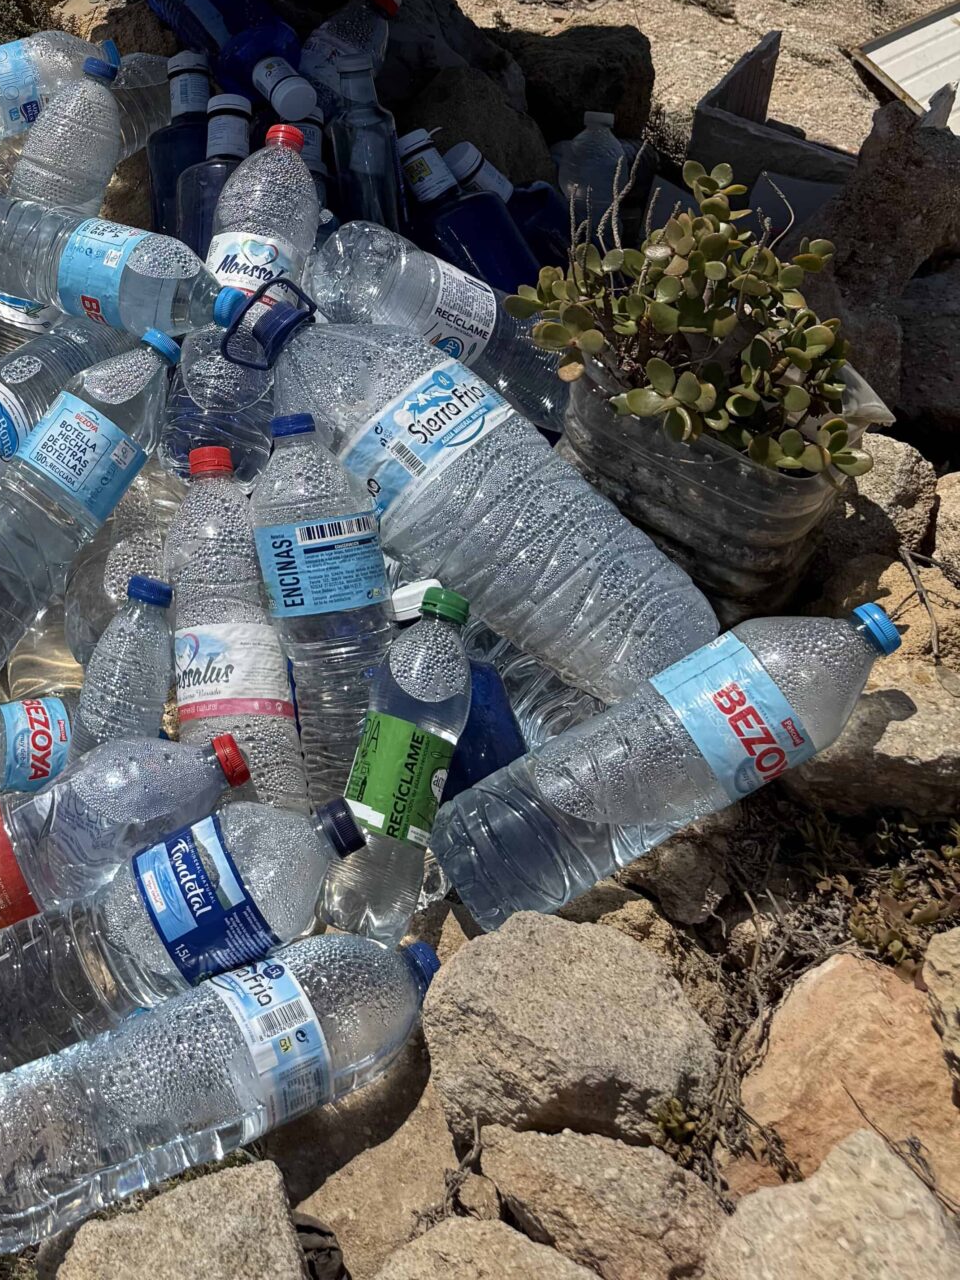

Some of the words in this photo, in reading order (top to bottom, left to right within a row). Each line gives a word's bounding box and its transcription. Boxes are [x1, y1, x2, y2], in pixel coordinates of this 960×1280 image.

[435, 307, 490, 340] RECÍCLAME
[75, 413, 98, 433] BEZOYA
[407, 402, 462, 445] Sierra
[451, 383, 486, 408] Frío
[46, 434, 58, 444] DE
[59, 443, 89, 468] OTRAS
[58, 430, 87, 456] HECHA
[60, 420, 97, 452] BOTELLA
[41, 442, 84, 476] BOTELLAS
[48, 463, 76, 486] RECICLADA
[271, 538, 305, 608] ENCINAS
[711, 681, 789, 782] BEZOY
[385, 731, 425, 838] RECÍCLAME
[170, 838, 212, 917] Fondetal
[186, 848, 204, 873] MINERAL
[198, 874, 217, 903] NATURAL
[174, 943, 191, 963] 1,5L
[242, 972, 273, 1007] Frío
